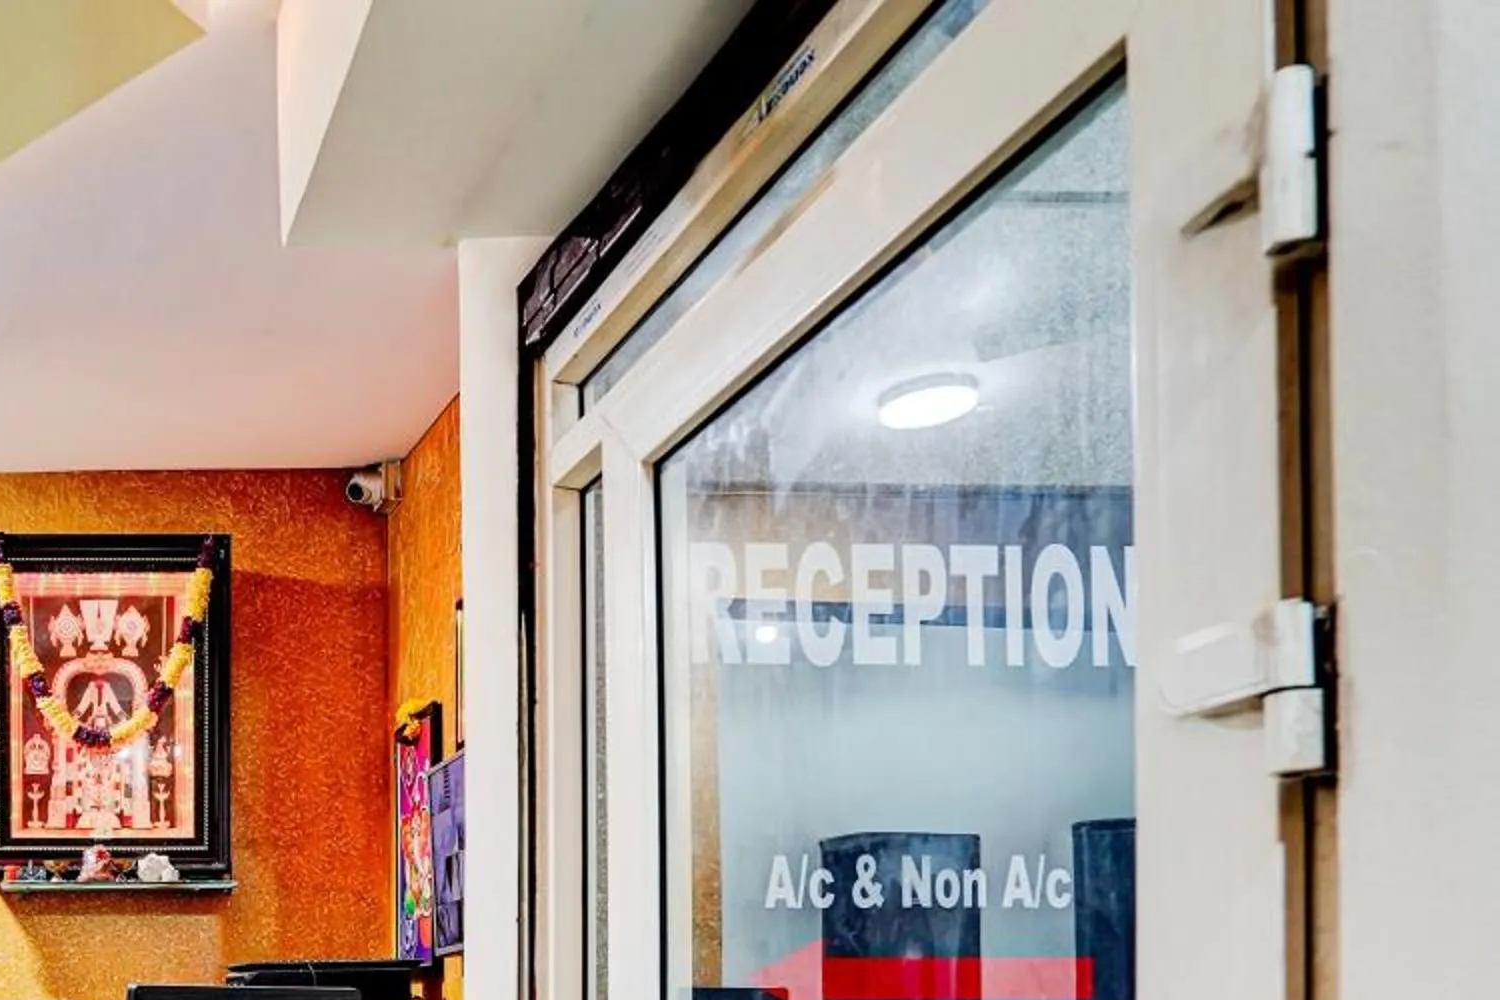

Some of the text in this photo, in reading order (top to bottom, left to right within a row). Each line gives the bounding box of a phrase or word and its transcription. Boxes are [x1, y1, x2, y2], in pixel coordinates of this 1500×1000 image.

[690, 541, 1139, 668] RECEPTION
[764, 854, 1073, 908] A/c & Non A/c
